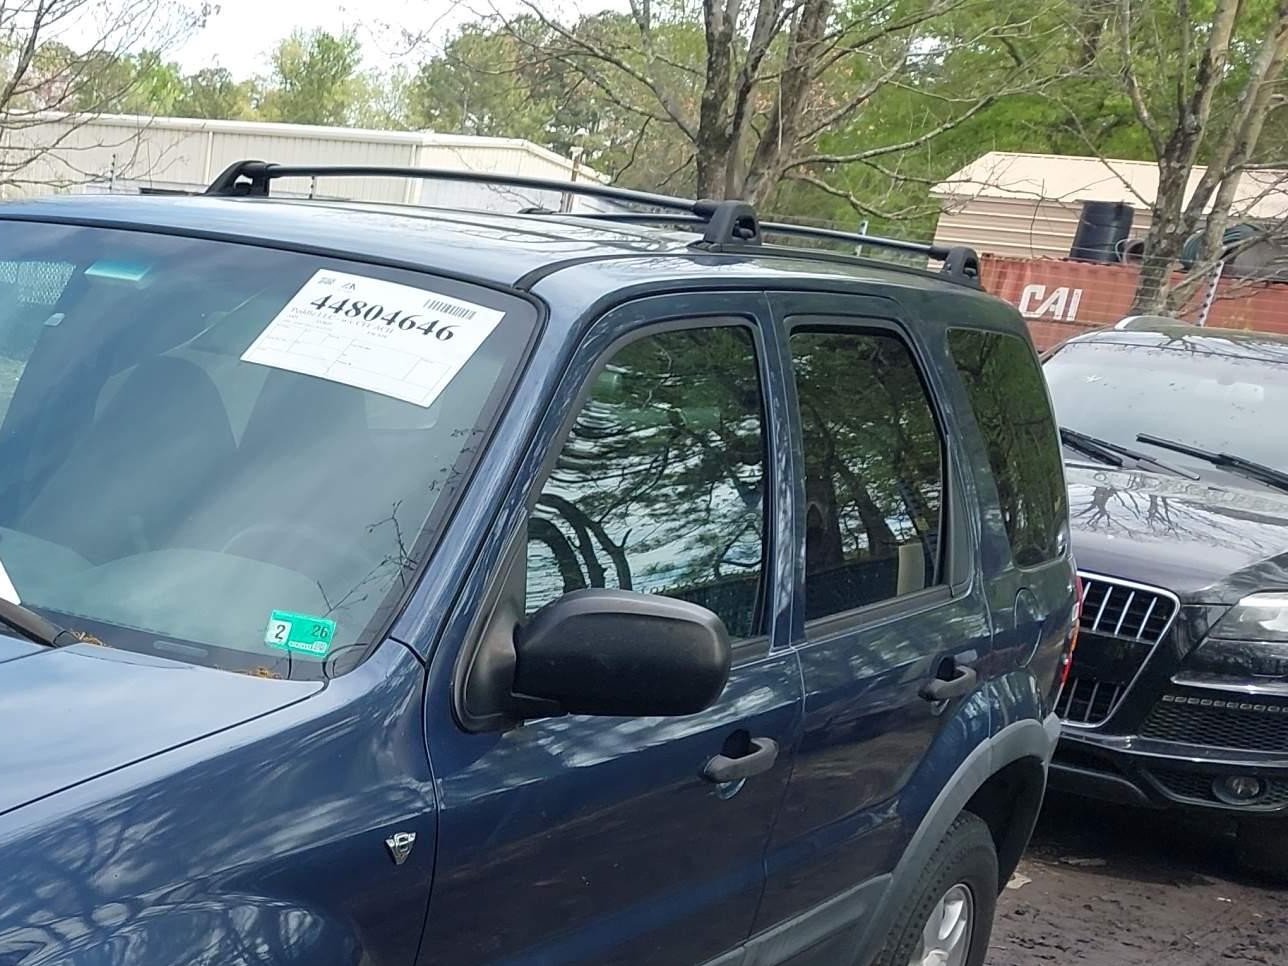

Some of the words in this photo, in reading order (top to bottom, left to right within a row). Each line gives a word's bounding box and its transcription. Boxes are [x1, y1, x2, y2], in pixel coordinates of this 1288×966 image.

[1018, 283, 1083, 322] CAI
[310, 294, 460, 342] 44804646
[275, 625, 286, 640] 2
[312, 625, 328, 639] 26
